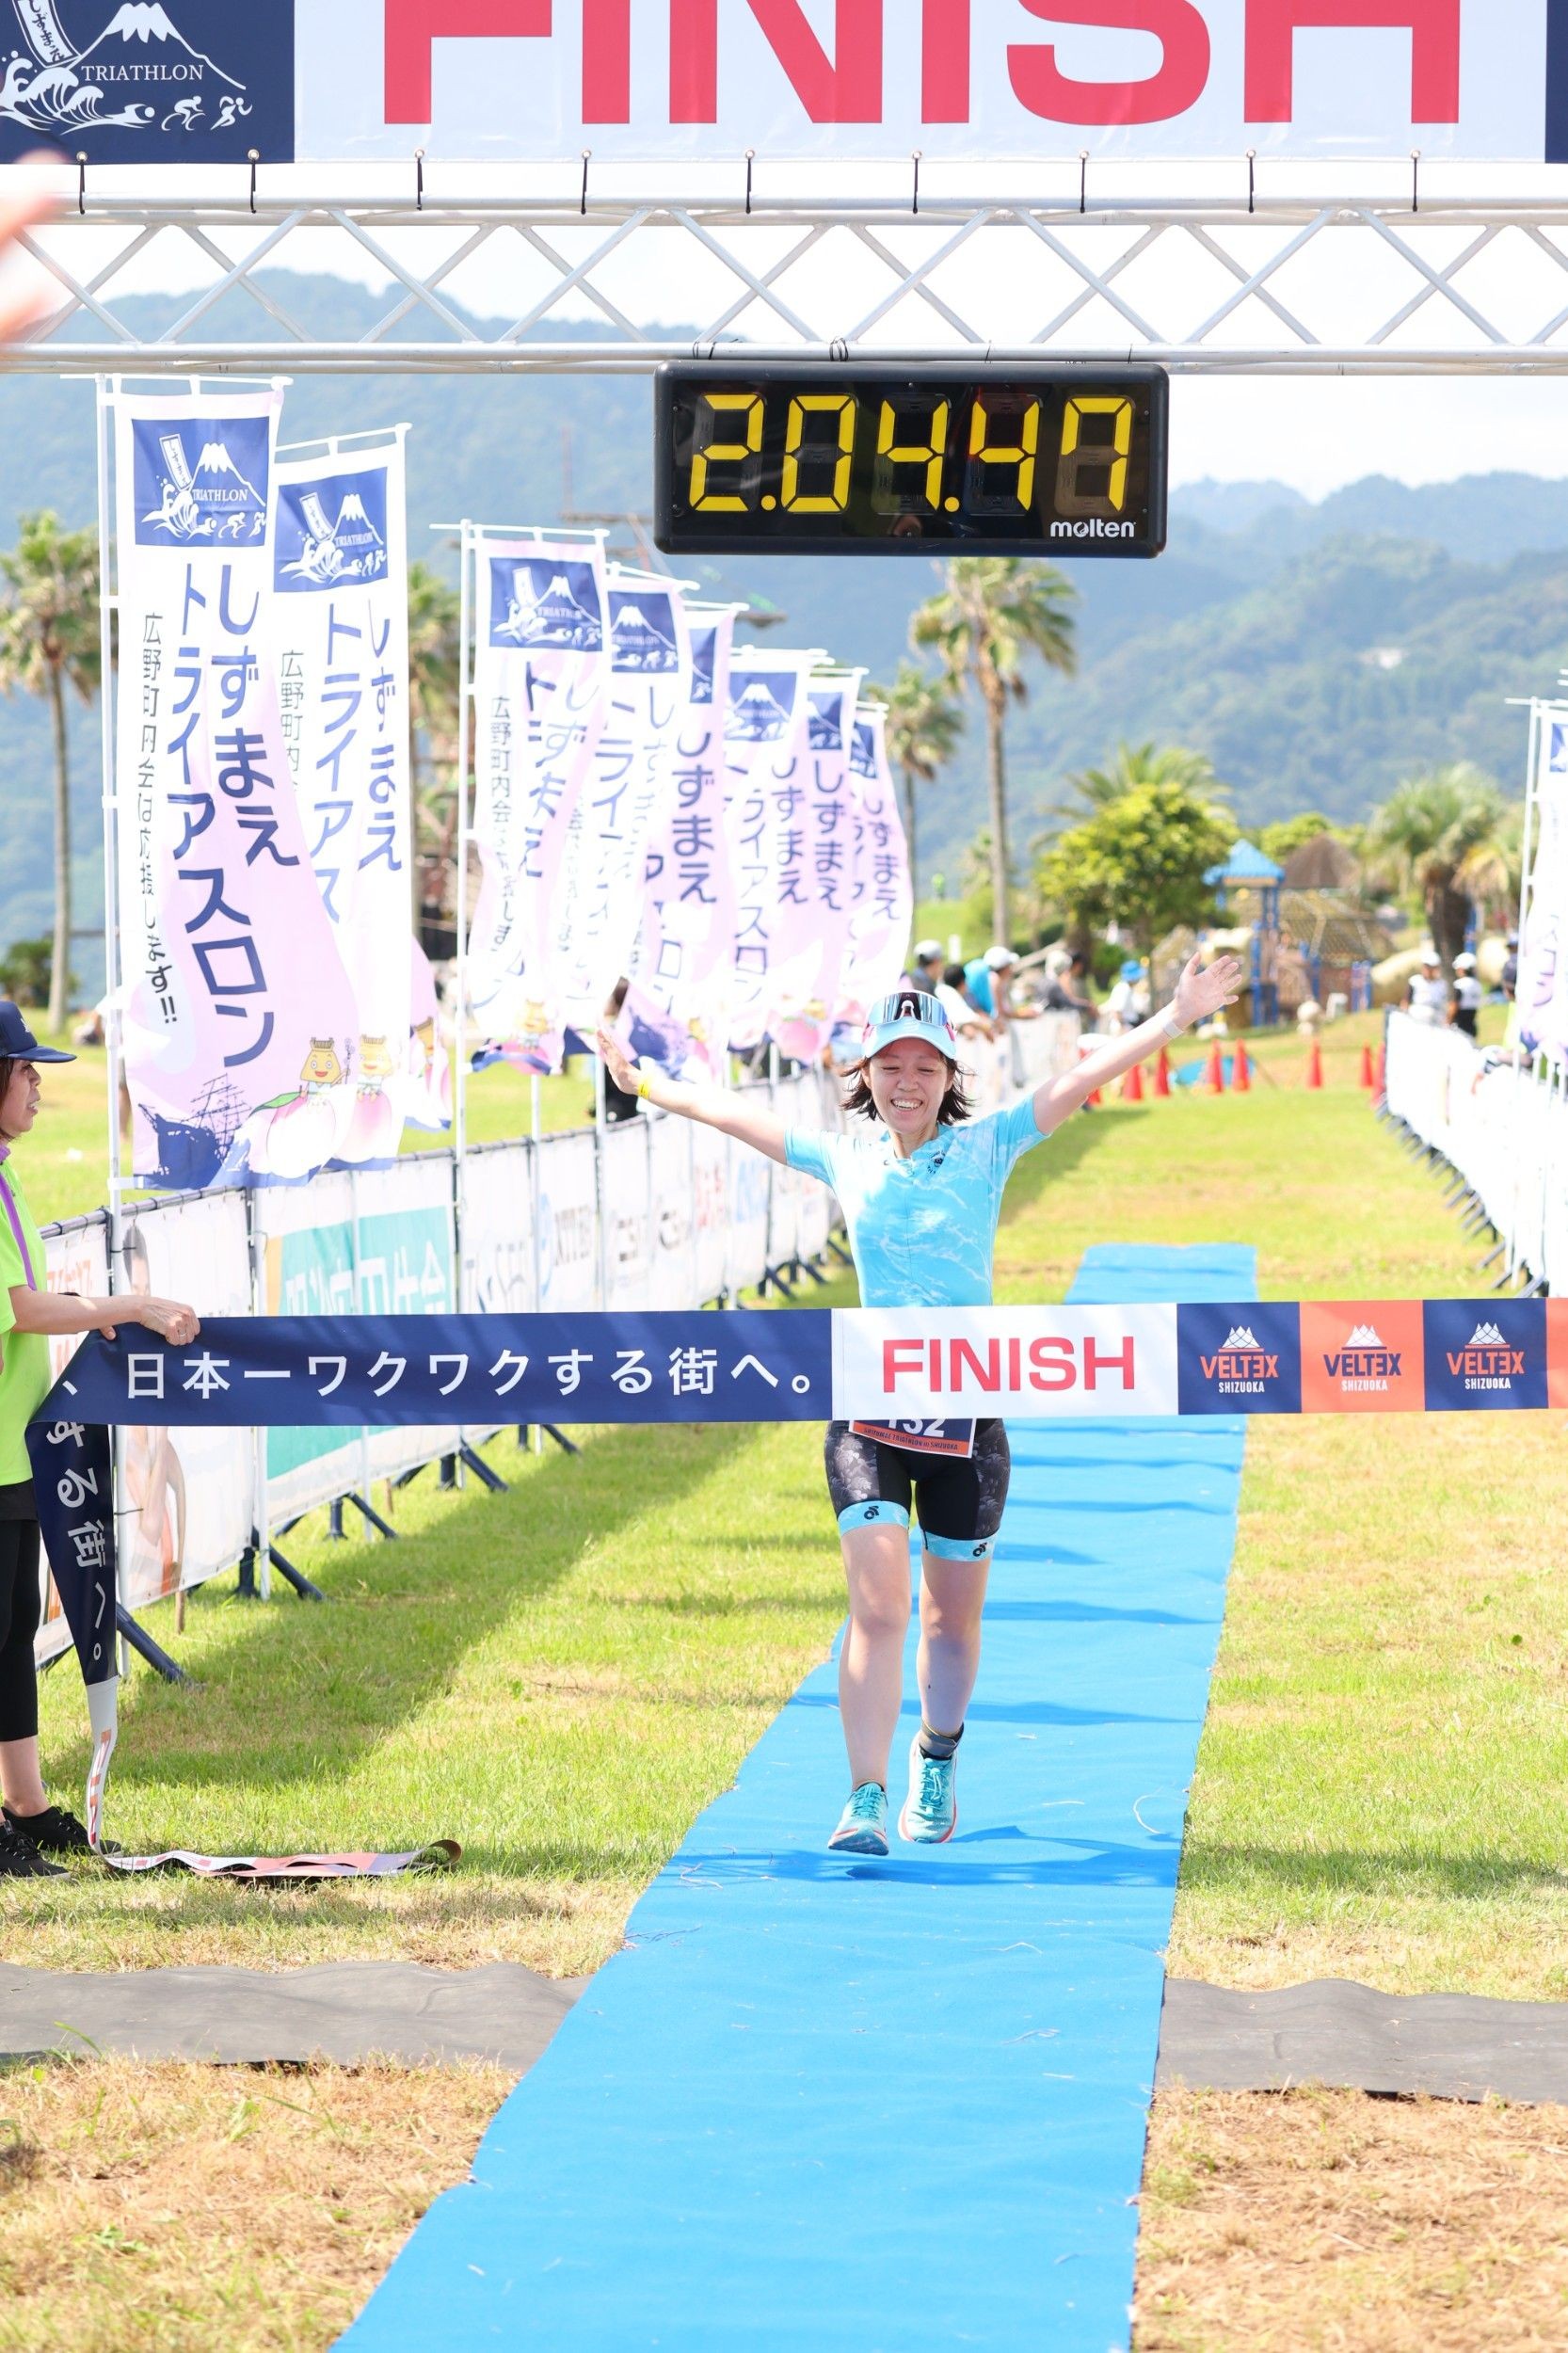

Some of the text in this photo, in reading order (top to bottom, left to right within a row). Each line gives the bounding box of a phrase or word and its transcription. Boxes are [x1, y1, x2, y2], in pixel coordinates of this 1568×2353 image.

[81, 64, 204, 82] TRIATHLON
[192, 488, 248, 502] TRIATHLON
[1050, 519, 1136, 538] molten
[211, 565, 300, 867] しずまえ
[280, 649, 304, 792] 広野町内
[167, 563, 275, 1067] トライアスロン
[671, 731, 717, 903] しずまえ
[771, 757, 809, 904] しずまえ
[810, 760, 845, 911] しずまえ
[881, 1336, 1135, 1393] FINISH
[1218, 1381, 1265, 1393] SHIZUOKA
[1341, 1380, 1388, 1392] SHIZUOKA
[1464, 1377, 1512, 1389] SHIZUOKA
